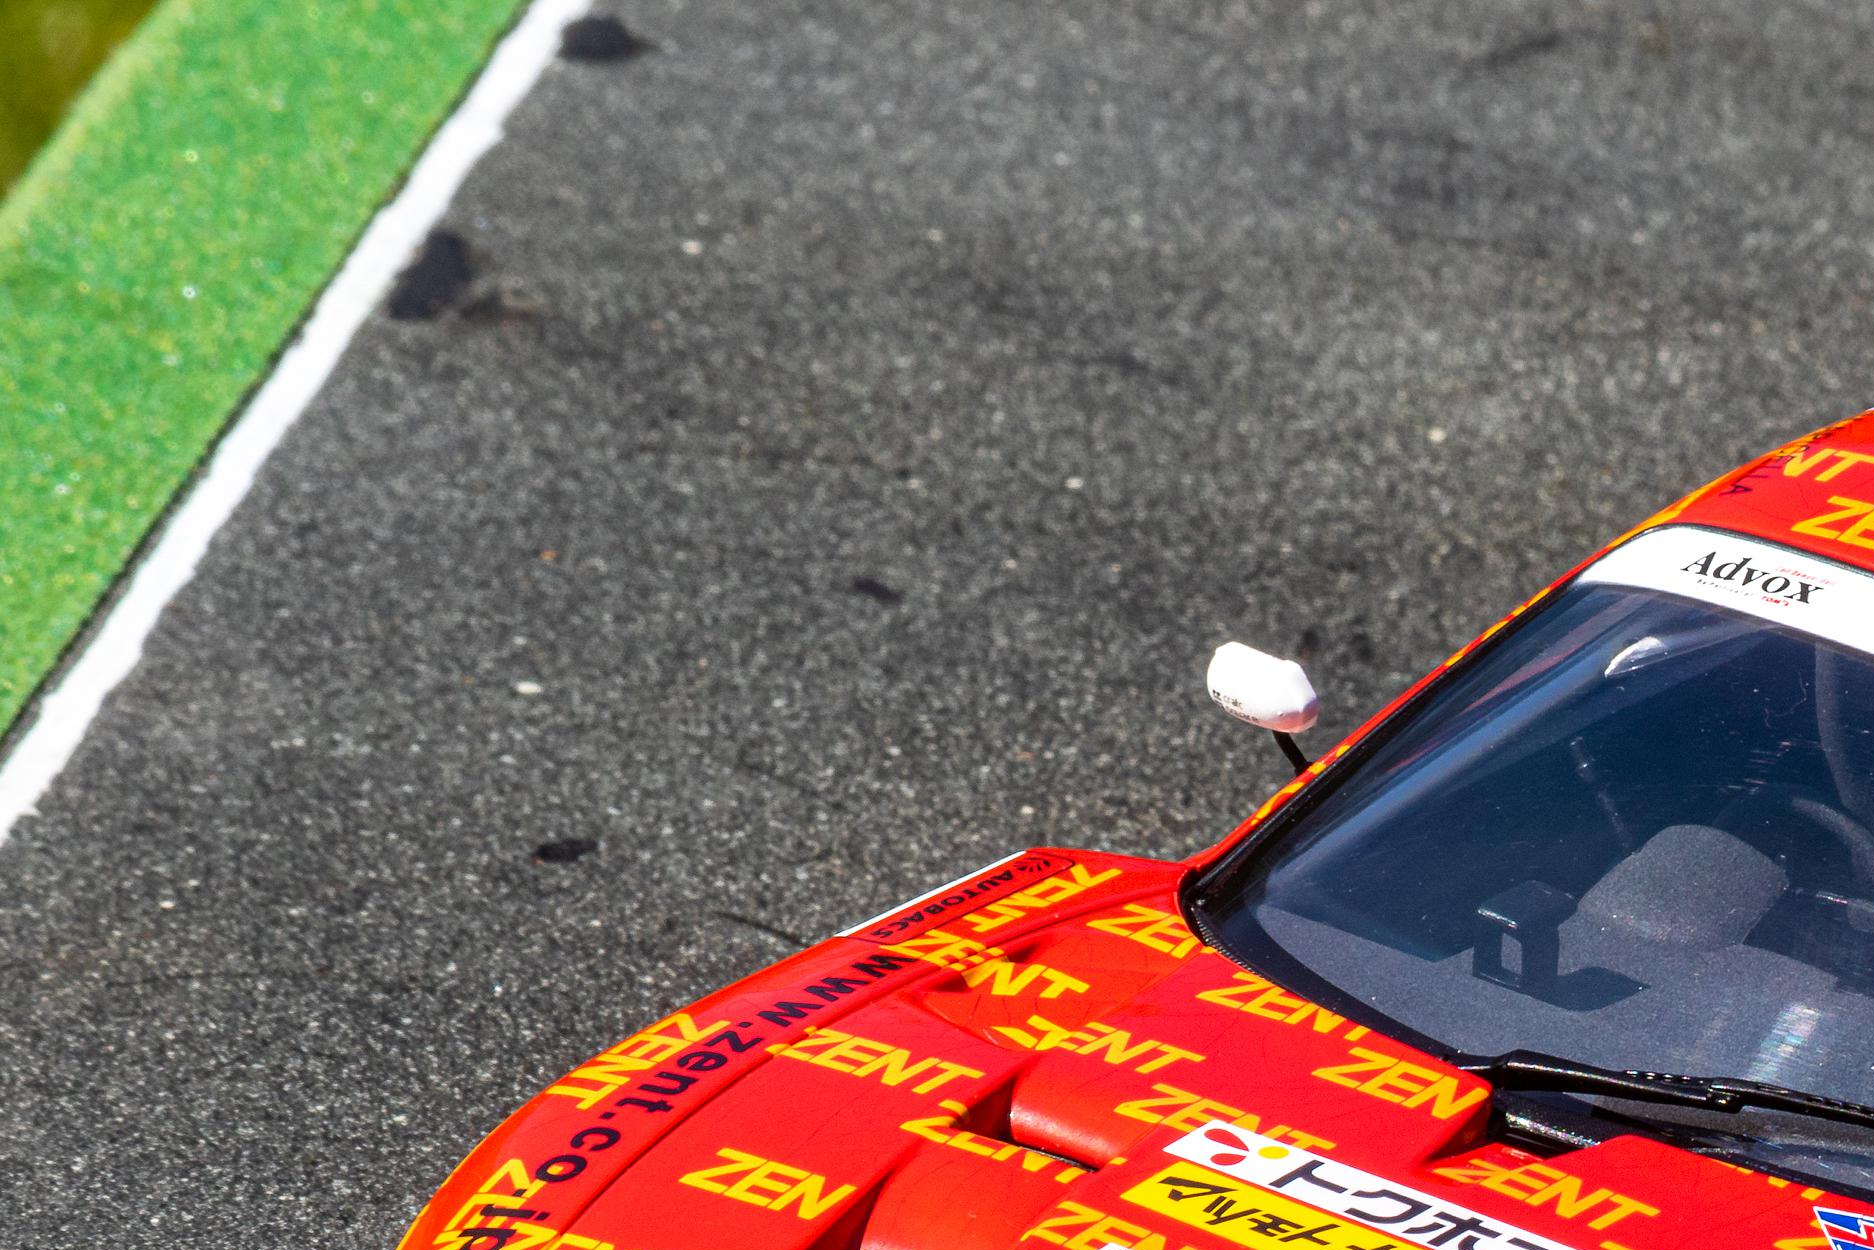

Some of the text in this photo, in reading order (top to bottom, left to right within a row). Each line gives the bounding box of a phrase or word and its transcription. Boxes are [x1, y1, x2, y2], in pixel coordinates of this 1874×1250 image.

[1680, 551, 1824, 604] Advox
[870, 871, 1016, 941] AUTOBACS
[962, 863, 1123, 934] ZENT
[1196, 971, 1375, 1044] ZEN
[545, 1012, 732, 1110] ZENT
[767, 1024, 986, 1094] ZENT
[1312, 1046, 1488, 1121] ZEN
[678, 1147, 856, 1221] ZEN
[1433, 1149, 1662, 1232] ZENT
